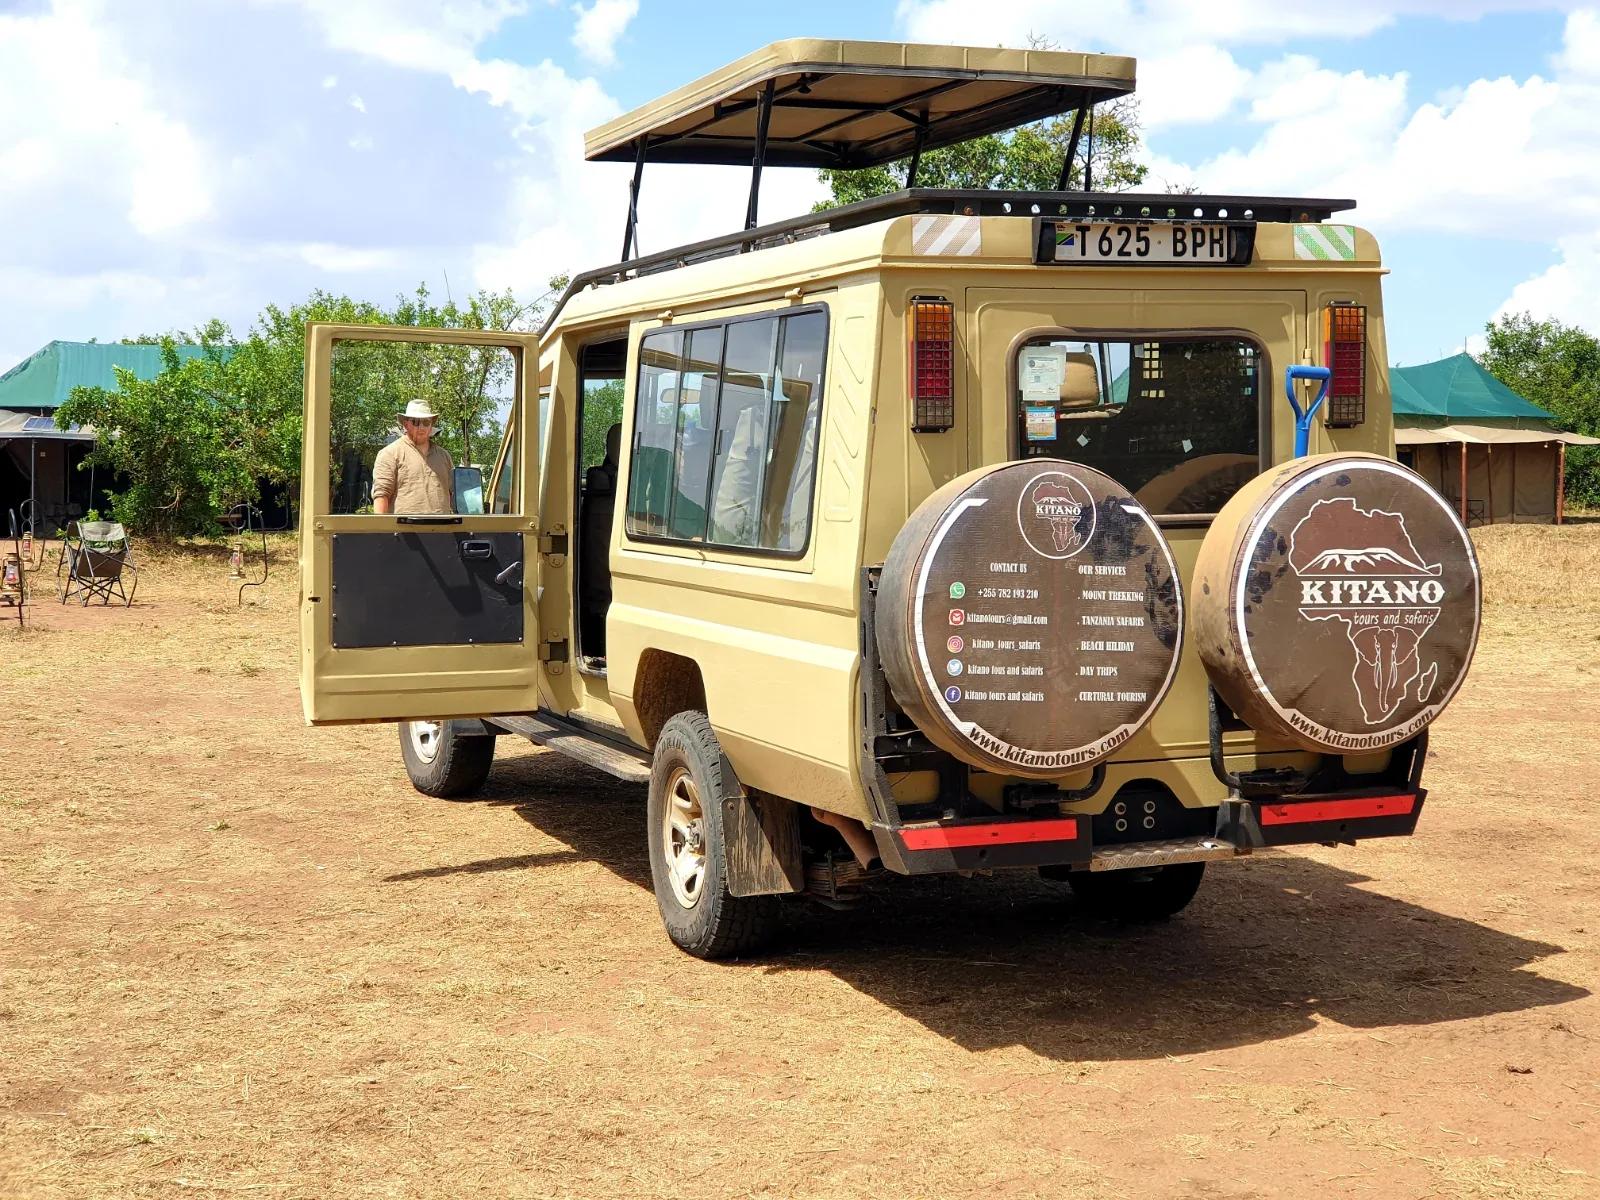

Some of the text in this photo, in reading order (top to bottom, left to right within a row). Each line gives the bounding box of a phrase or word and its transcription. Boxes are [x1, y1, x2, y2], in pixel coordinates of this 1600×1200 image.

[1075, 225, 1224, 258] T 625 BPH
[1036, 505, 1081, 516] KITANO
[989, 562, 1028, 573] CONTACT US
[1078, 564, 1127, 576] OUR SERVICES
[977, 587, 1039, 599] +255 782 193 210
[1082, 590, 1144, 602] MOUNT TREKKING
[1300, 579, 1446, 604] KITANO
[966, 612, 1048, 626] kitanotours@gmail.com
[1081, 615, 1145, 627] TANZANIA SAFARIS
[1354, 609, 1435, 626] tours and safaris
[972, 638, 1041, 651] kitano_tours_safaris
[1080, 640, 1104, 651] BEACH
[967, 664, 990, 675] kitano
[1006, 665, 1020, 676] and
[1021, 665, 1044, 676] safaris
[1080, 666, 1118, 677] DAY TRIPS
[964, 689, 1045, 702] kitano tours and safaris
[1116, 692, 1147, 702] TOURISM
[1289, 708, 1434, 749] www.kitanotours.com
[969, 727, 1130, 767] www.kitanotours.com
